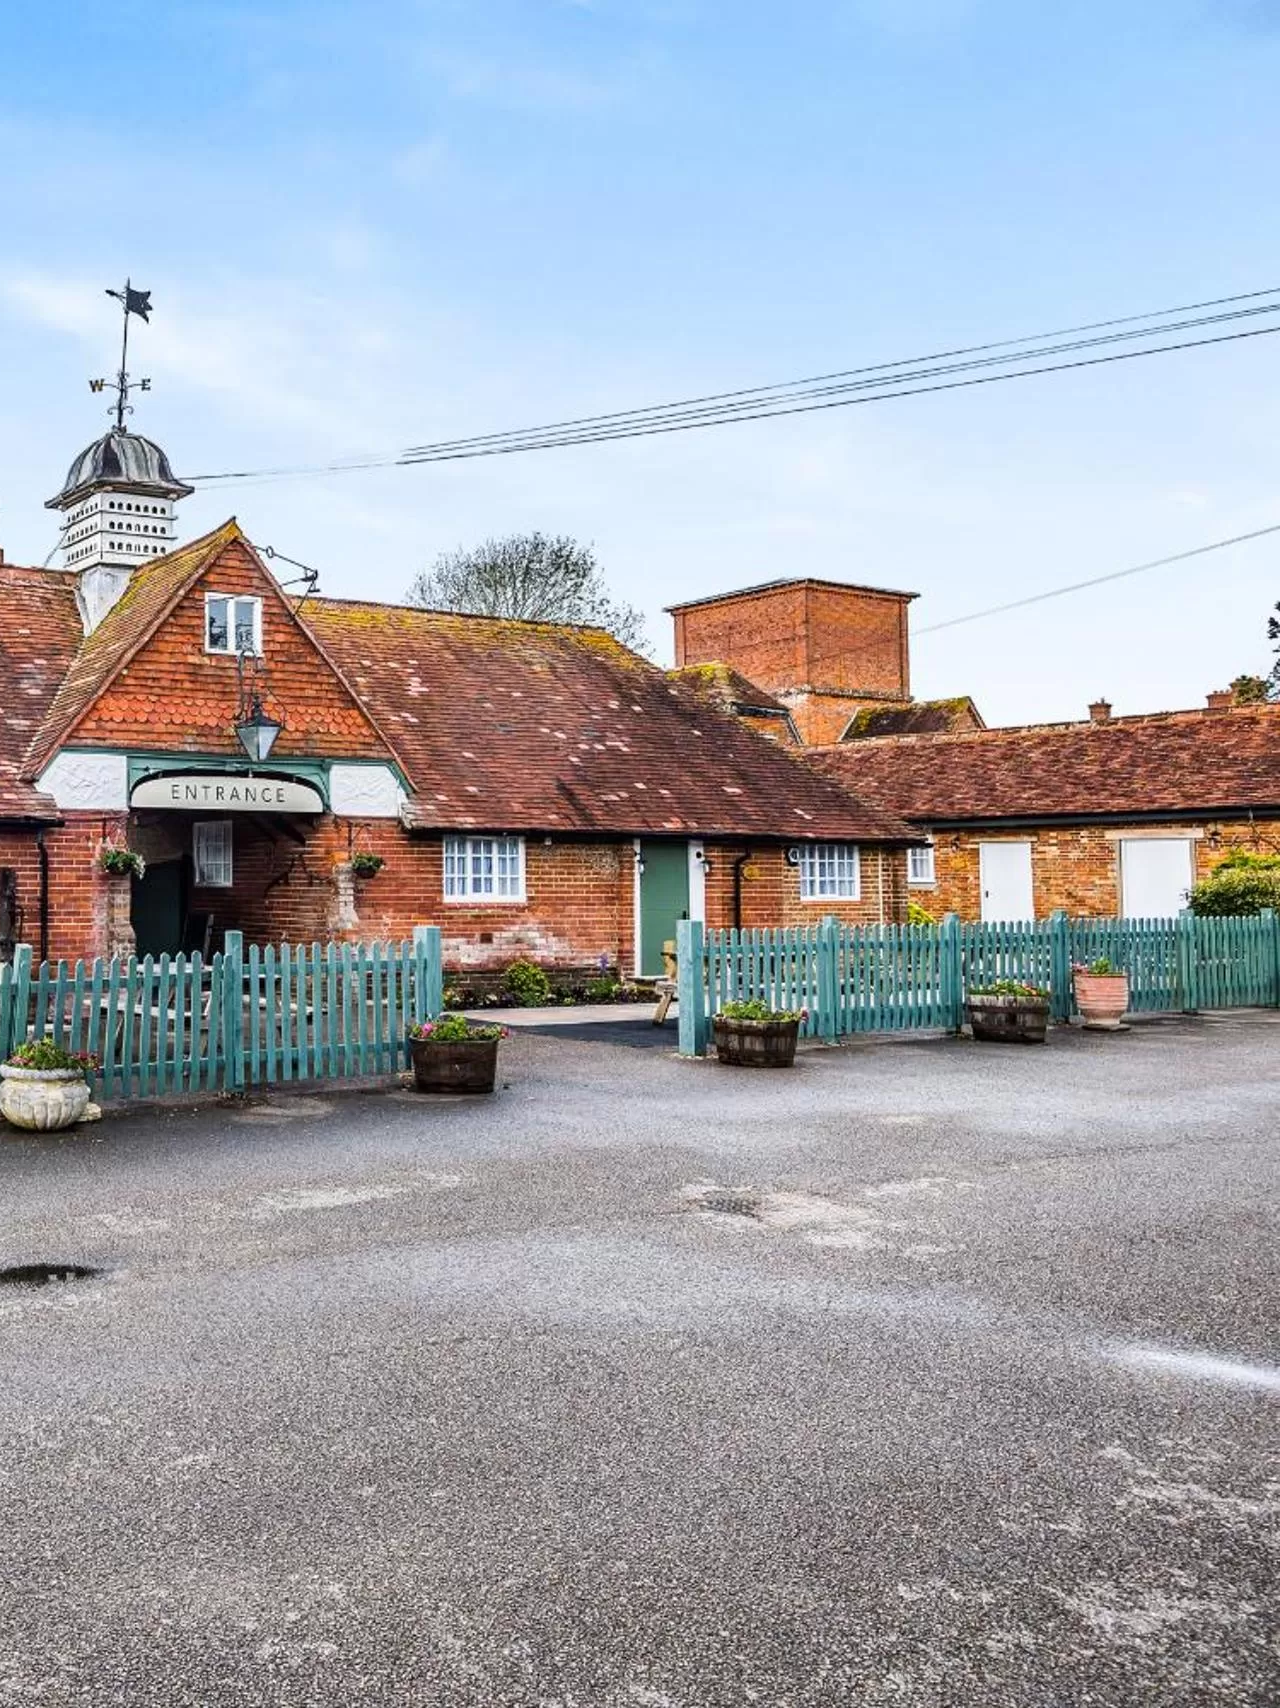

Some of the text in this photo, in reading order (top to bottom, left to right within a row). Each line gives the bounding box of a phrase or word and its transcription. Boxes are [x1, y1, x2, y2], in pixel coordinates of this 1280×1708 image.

[89, 378, 105, 393] W
[141, 378, 151, 391] E
[171, 784, 286, 803] ENTRANCE
